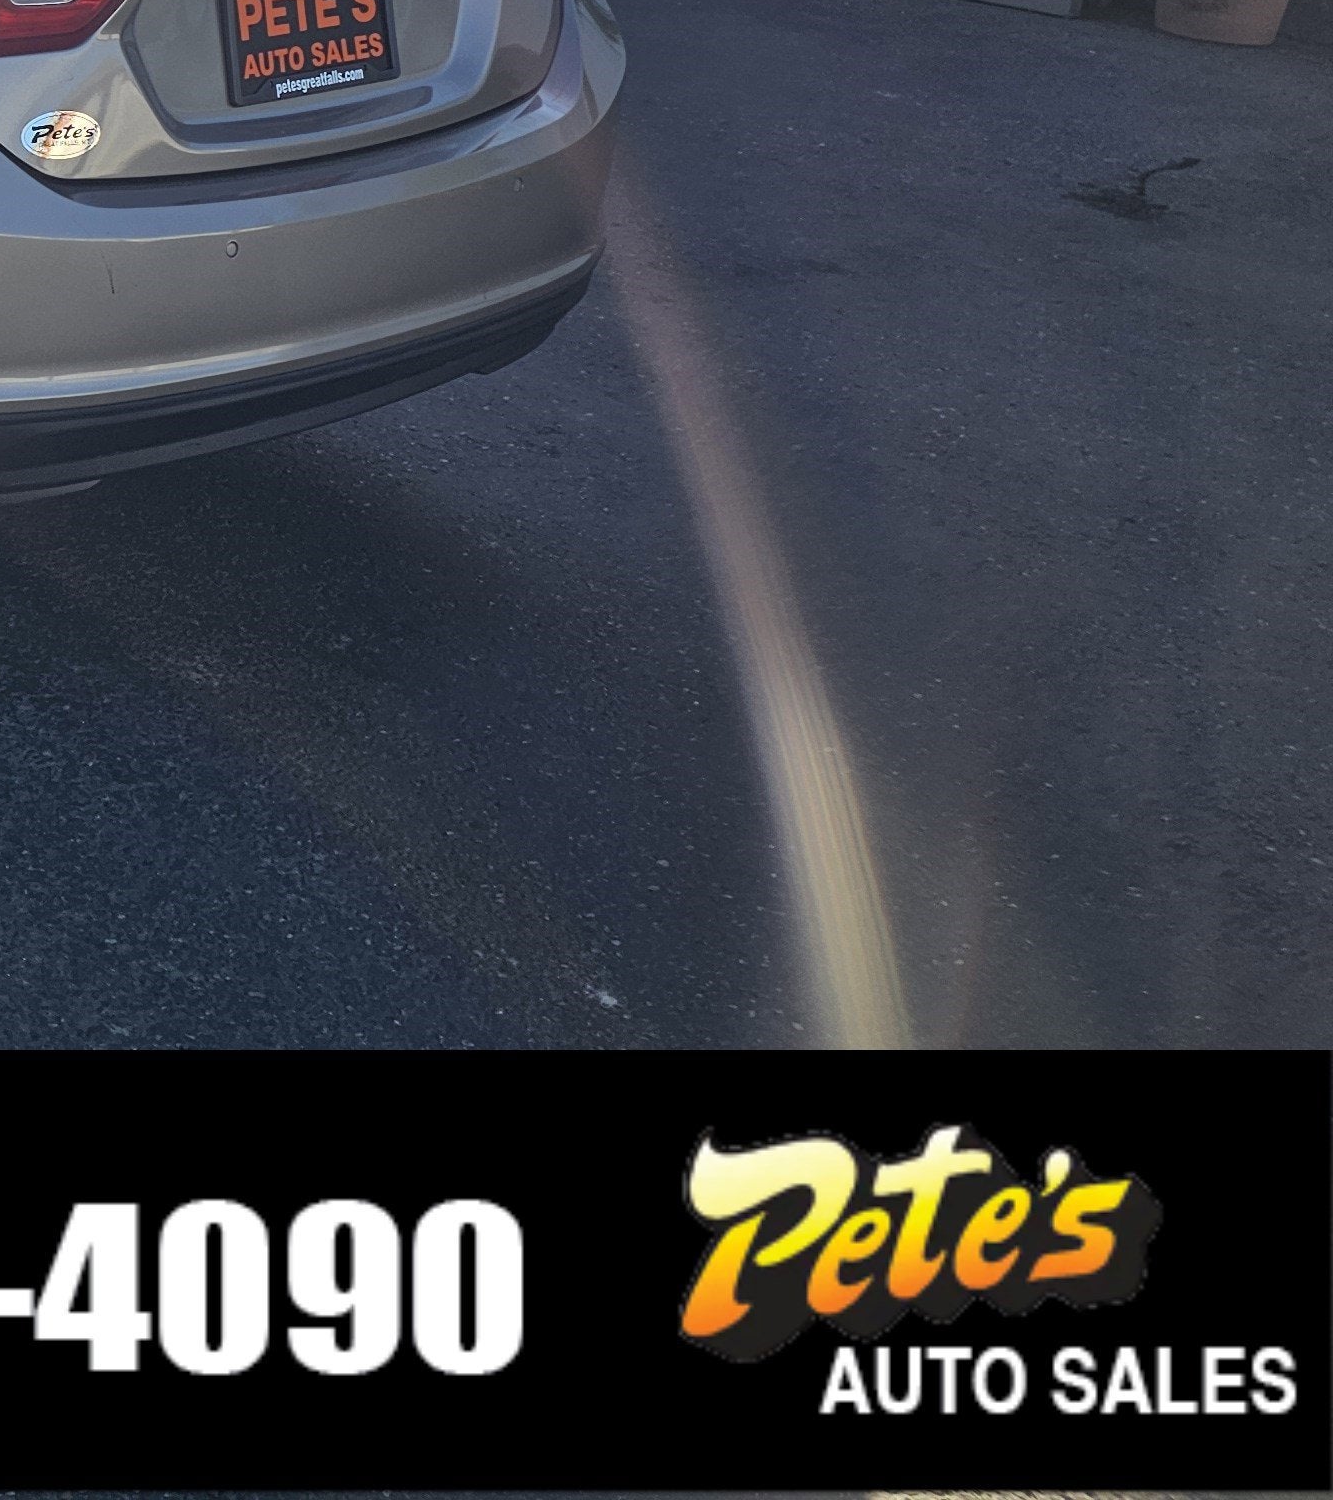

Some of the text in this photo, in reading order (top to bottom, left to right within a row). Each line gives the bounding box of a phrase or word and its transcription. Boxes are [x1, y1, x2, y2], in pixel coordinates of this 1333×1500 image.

[244, 32, 384, 79] AUTO SALES
[275, 68, 364, 98] petesgreatfalls.com
[31, 124, 96, 144] Pete's
